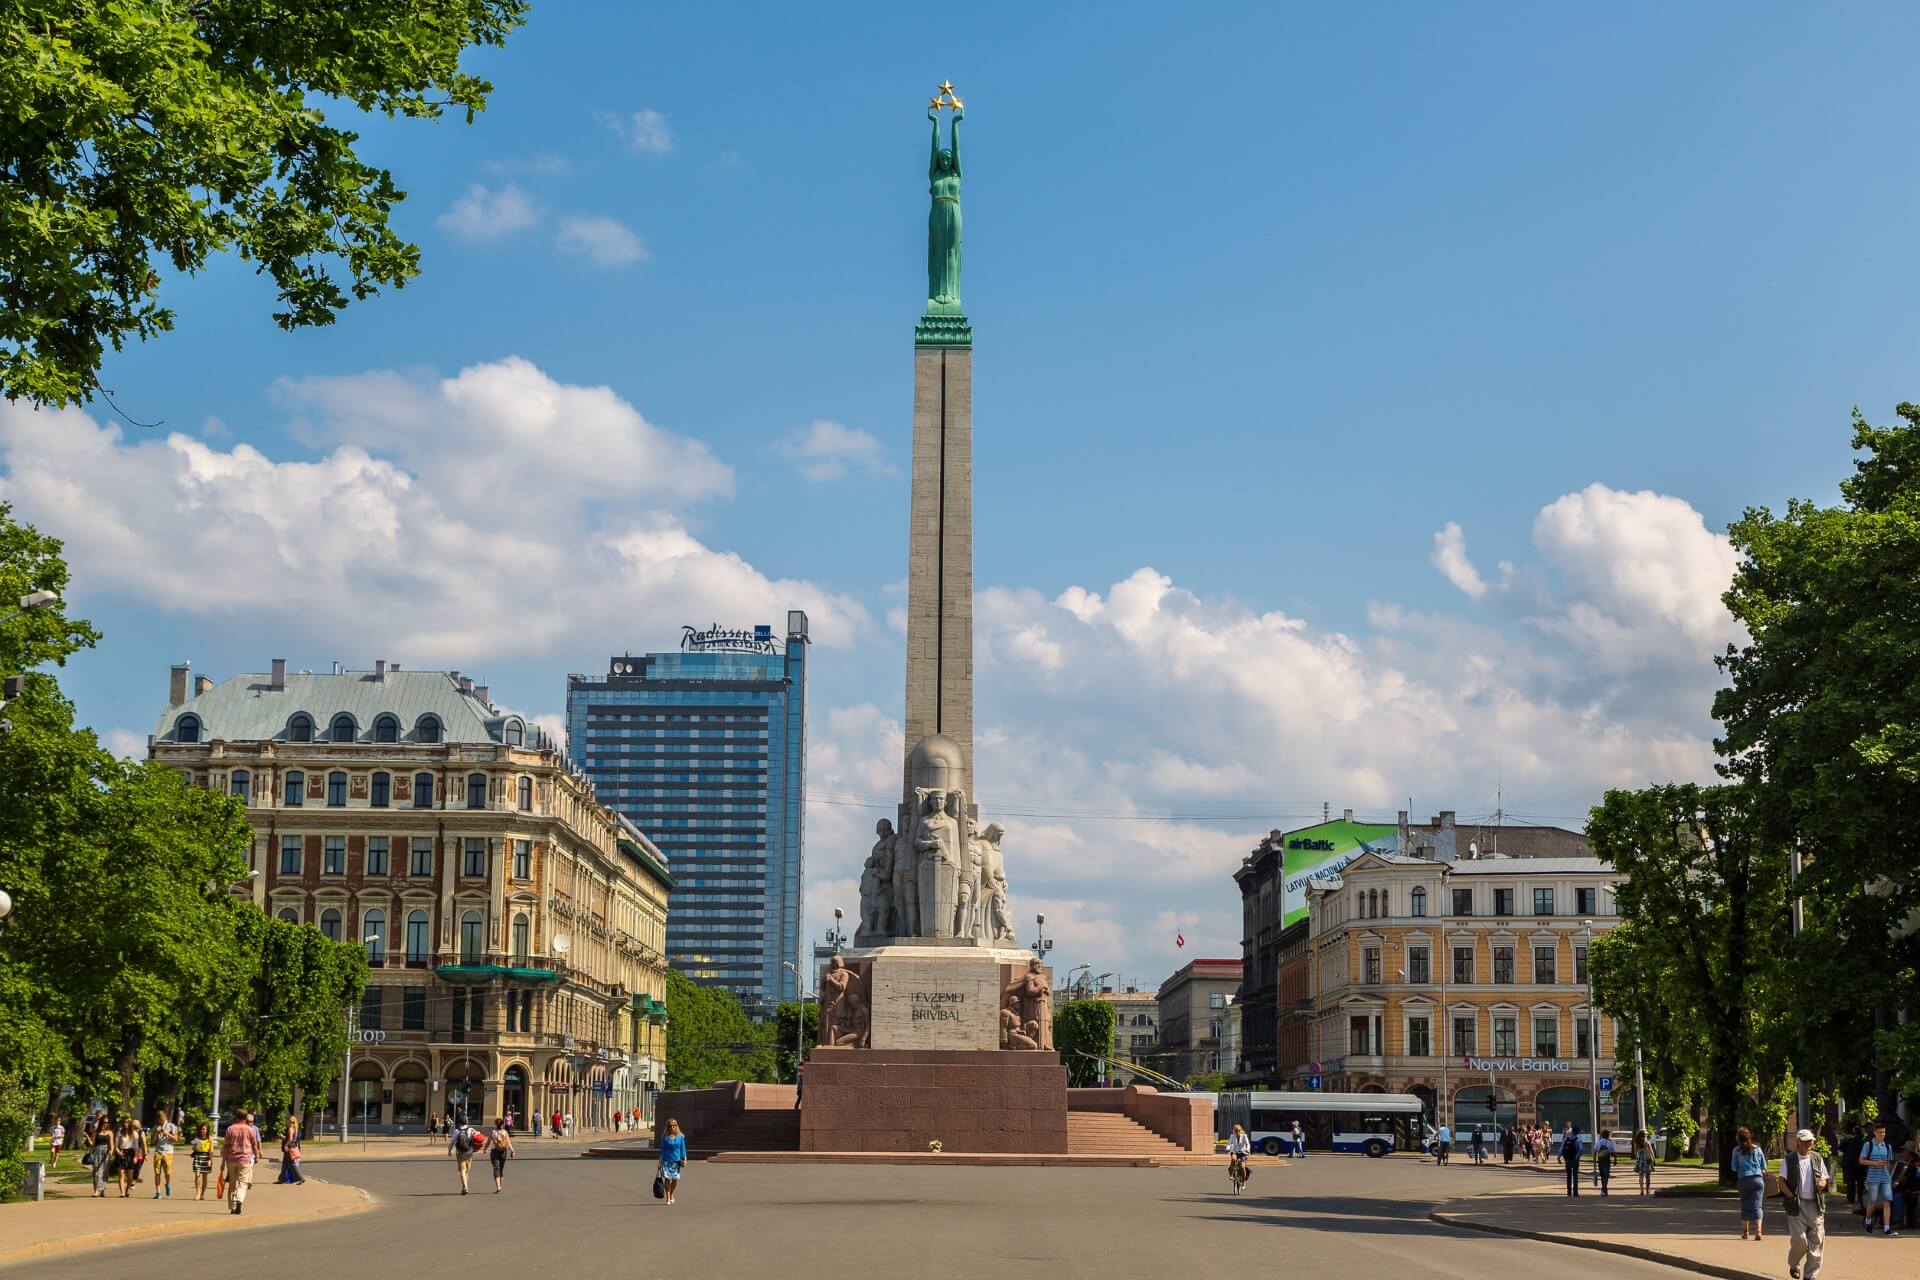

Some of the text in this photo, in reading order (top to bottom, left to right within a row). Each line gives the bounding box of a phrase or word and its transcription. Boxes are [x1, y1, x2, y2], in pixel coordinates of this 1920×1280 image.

[681, 622, 752, 648] Radisson
[1289, 838, 1335, 851] airBaltic
[1469, 1057, 1569, 1072] Norvik Banka
